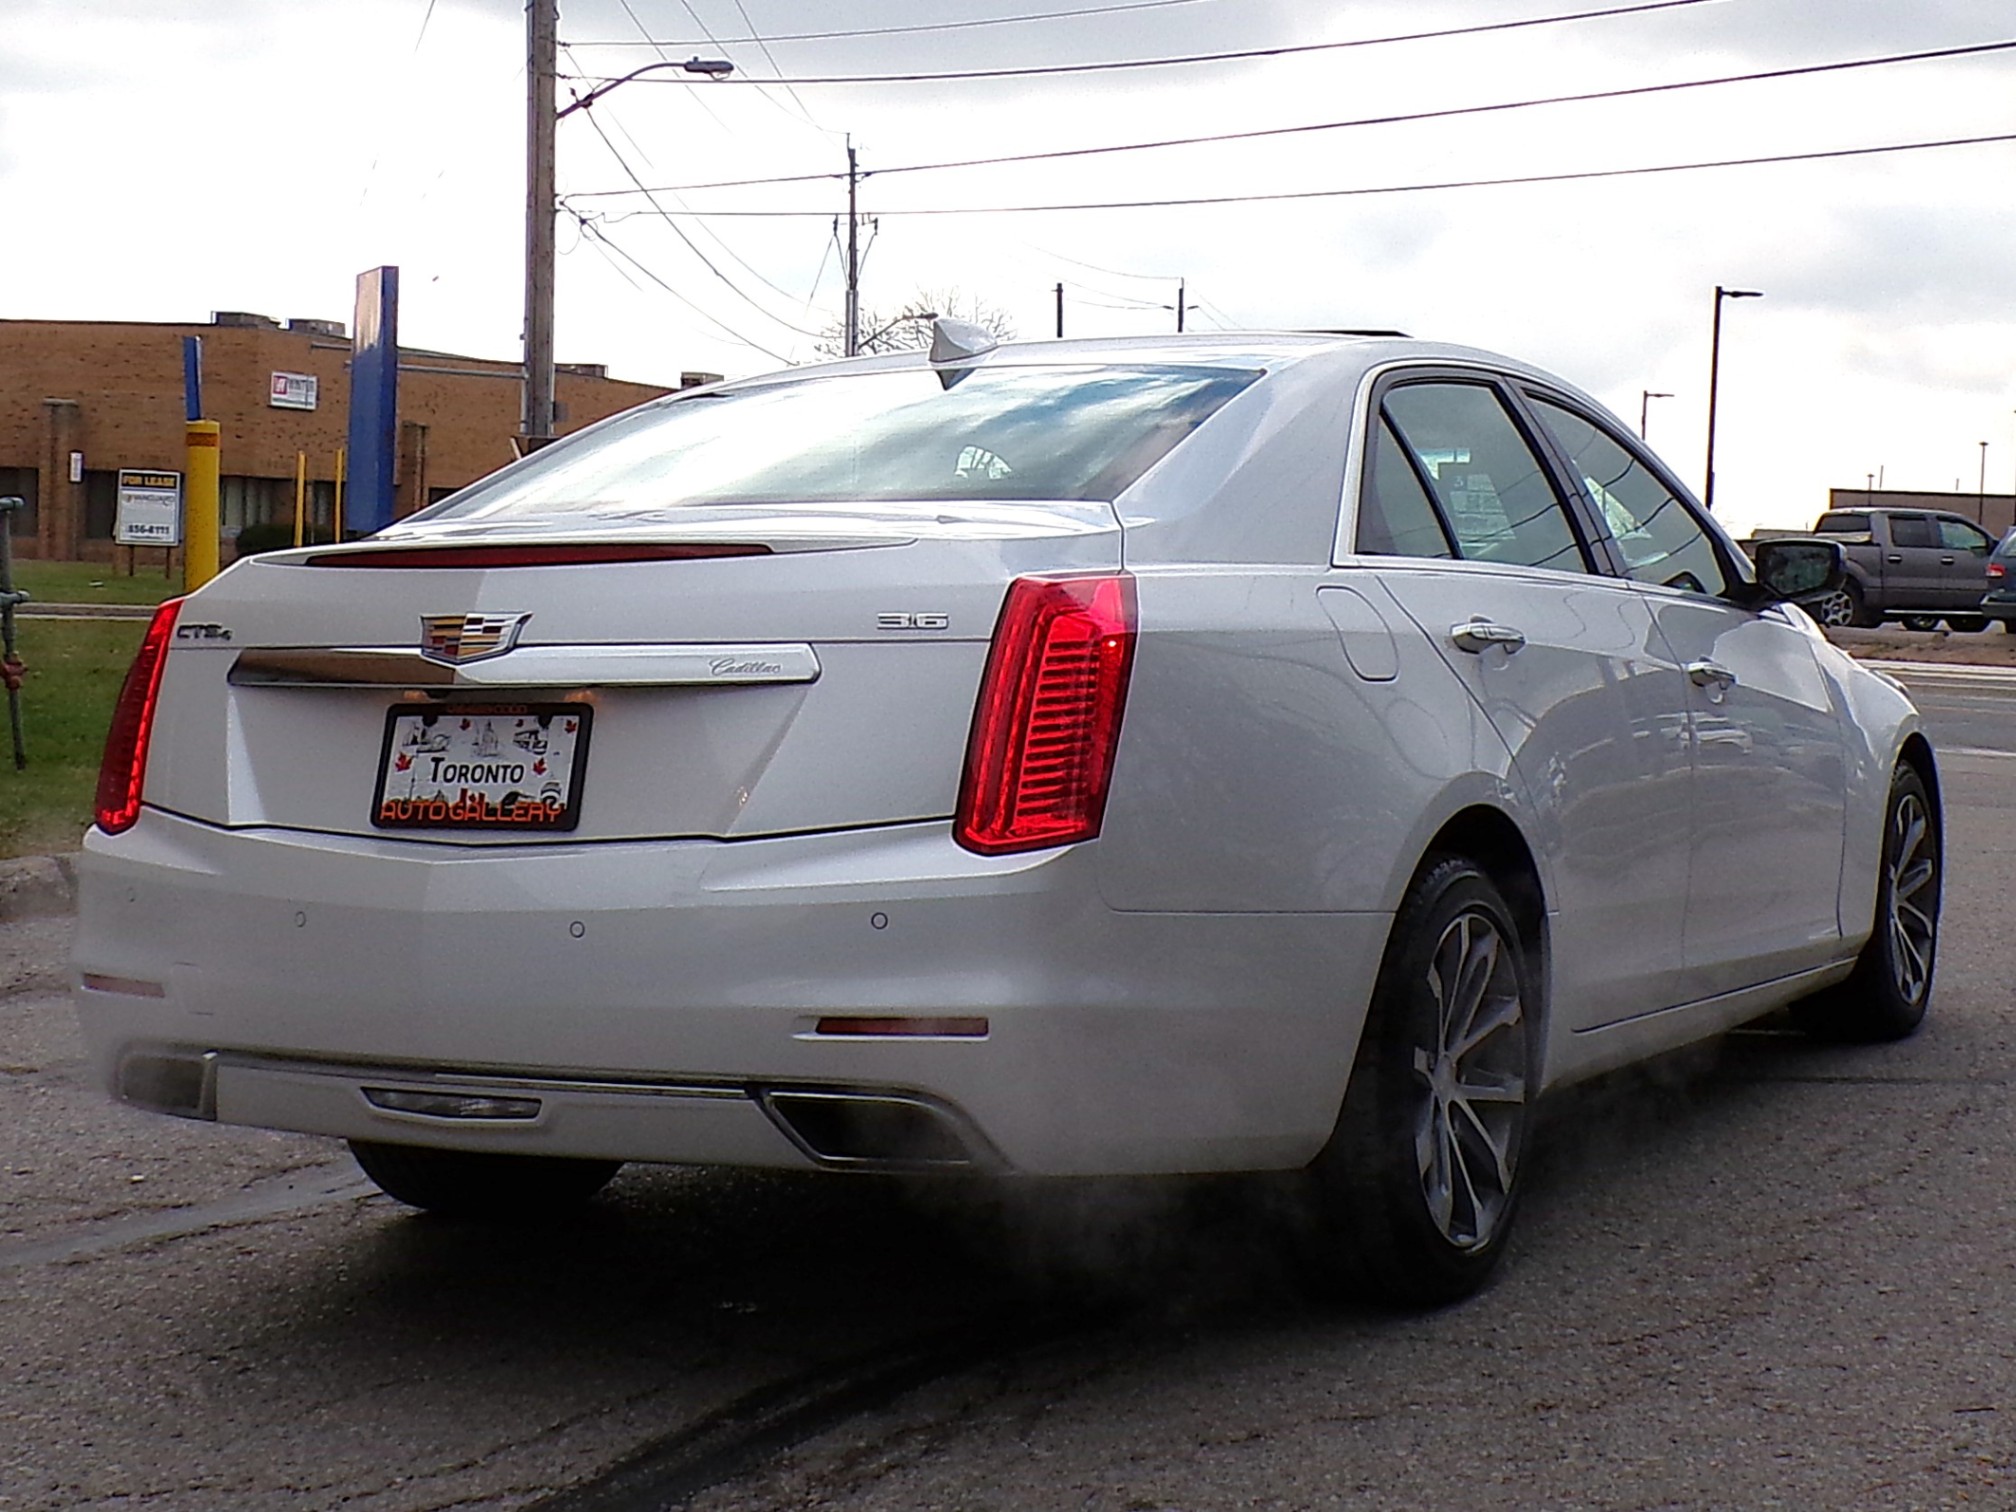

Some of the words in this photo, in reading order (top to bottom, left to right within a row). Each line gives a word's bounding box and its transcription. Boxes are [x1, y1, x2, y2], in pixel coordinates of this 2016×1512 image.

[123, 475, 143, 485] FOR
[144, 477, 175, 486] LEASE
[708, 658, 782, 676] Cadillac
[429, 757, 525, 784] TORONTO
